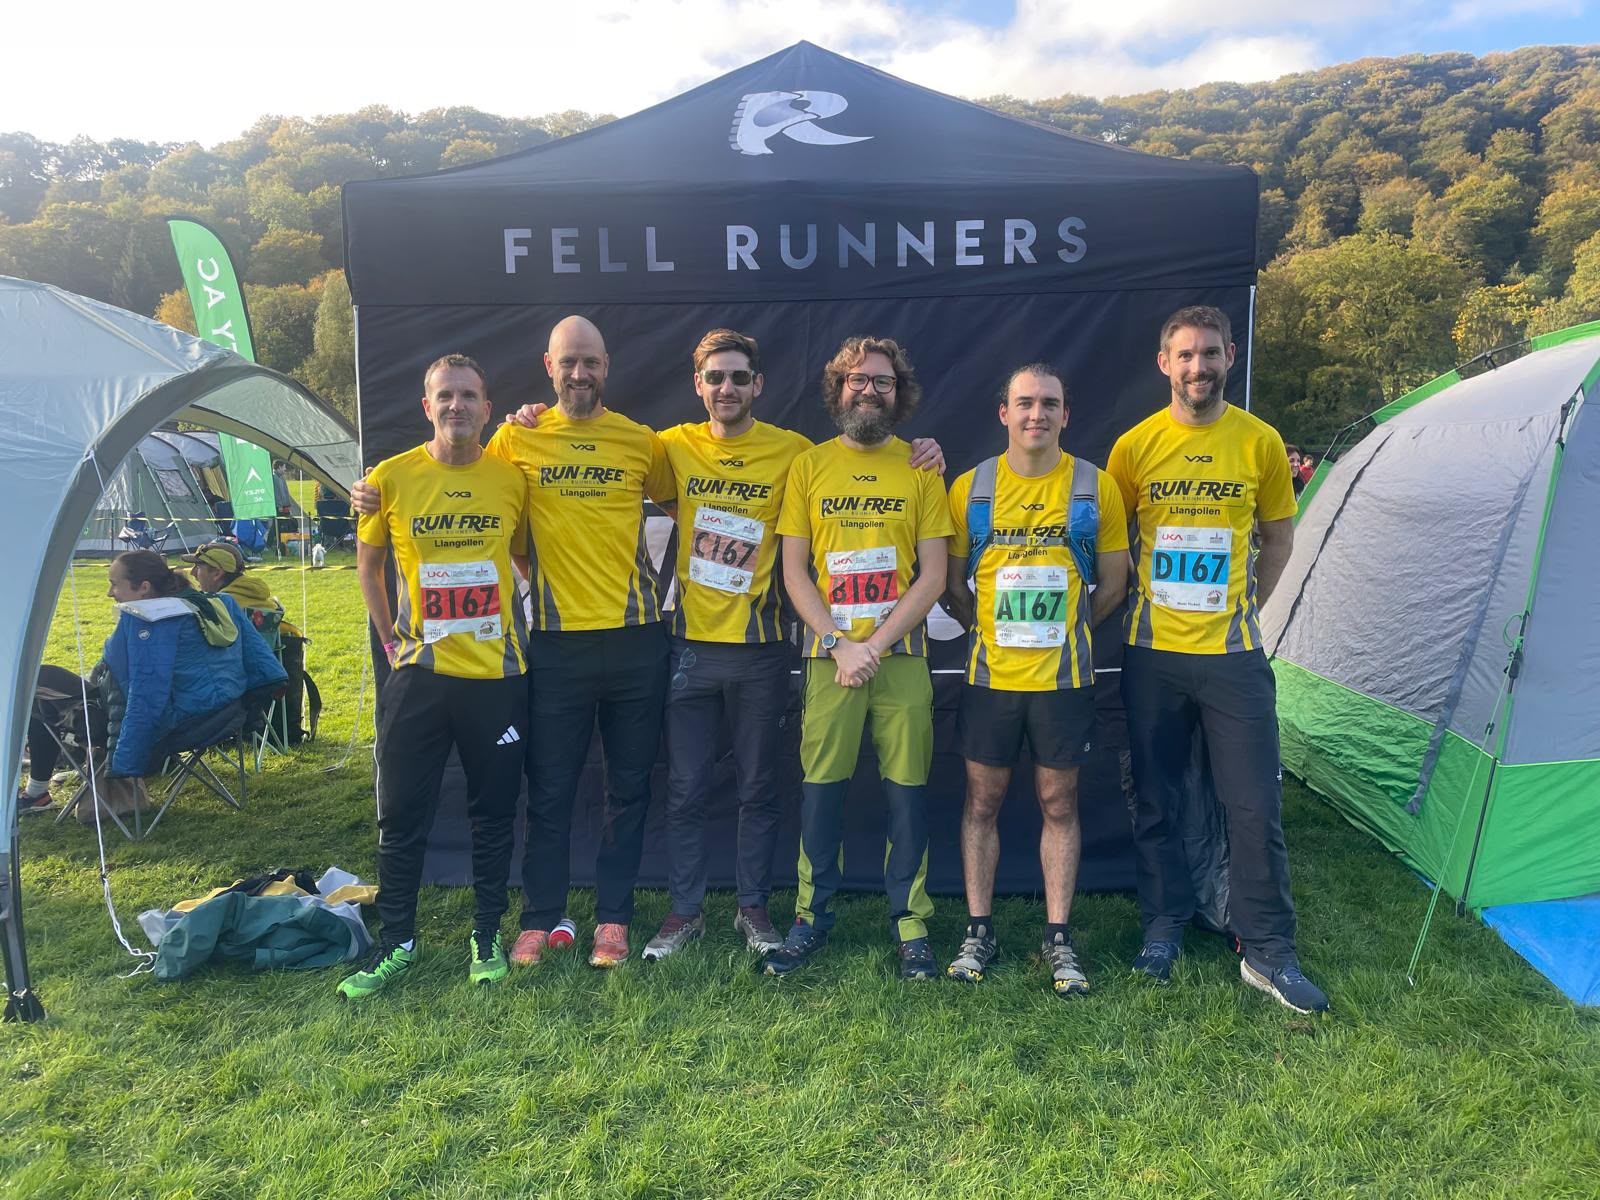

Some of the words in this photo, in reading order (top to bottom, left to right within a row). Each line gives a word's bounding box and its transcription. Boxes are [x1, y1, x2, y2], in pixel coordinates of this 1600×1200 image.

[503, 225, 675, 275] FELL
[725, 215, 1088, 271] RUNNERS
[1184, 455, 1213, 463] VX3
[560, 488, 607, 498] Llangollen
[1170, 506, 1221, 516] Llangollen
[840, 520, 885, 530] Llangollen
[434, 538, 484, 548] Llangollen
[695, 531, 757, 569] C167
[1154, 551, 1228, 583] D167
[425, 586, 495, 619] B167
[996, 591, 1064, 621] A167
